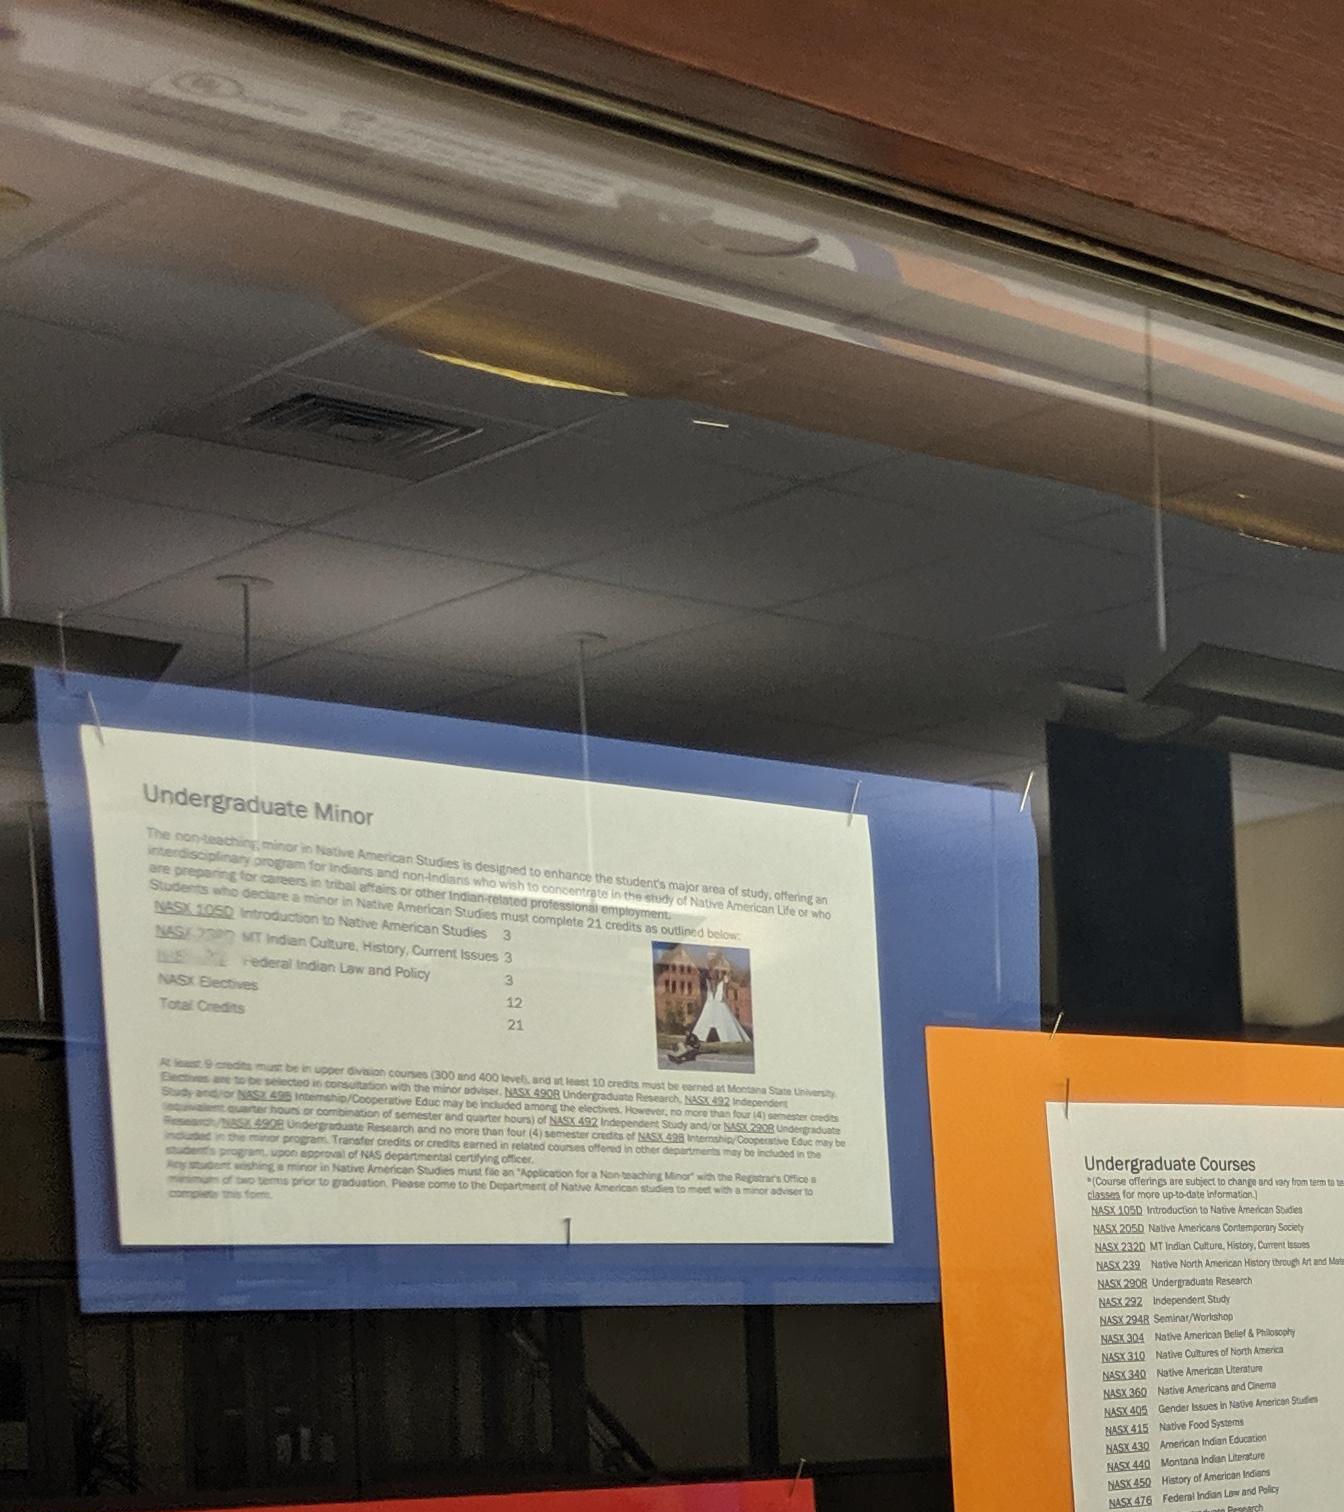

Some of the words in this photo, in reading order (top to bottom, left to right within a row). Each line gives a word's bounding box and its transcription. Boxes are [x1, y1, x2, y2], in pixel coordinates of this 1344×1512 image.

[142, 784, 308, 818] Undergraduate
[313, 801, 374, 825] Minor
[153, 899, 195, 917] NASX
[239, 907, 319, 924] Introduction
[337, 914, 378, 930] Native
[380, 919, 439, 934] American
[440, 923, 488, 939] Studies
[502, 928, 511, 942] 3
[241, 930, 262, 943] MT
[265, 933, 307, 946] Indian
[308, 935, 358, 952] Culture,
[361, 940, 409, 957] History,
[410, 943, 458, 959] Current
[459, 948, 499, 962] Issues
[503, 950, 513, 964] 3
[295, 959, 336, 972] Indian
[338, 961, 365, 975] Law
[366, 965, 392, 977] and
[394, 965, 431, 982] Policy
[503, 973, 514, 986] 3
[157, 972, 195, 986] NASX
[505, 996, 523, 1009] 12
[158, 996, 194, 1011] Total
[195, 999, 245, 1014] Credits
[506, 1018, 524, 1031] 21
[1083, 1155, 1196, 1174] Undergraduate
[1199, 1155, 1256, 1172] Courses
[1090, 1204, 1117, 1217] NASX
[1145, 1204, 1198, 1215] Introduction
[1209, 1204, 1236, 1214] Native
[1237, 1204, 1274, 1214] American
[1274, 1204, 1303, 1214] Studies
[1099, 1333, 1126, 1345] NASX
[1124, 1332, 1145, 1344] 304
[1154, 1331, 1182, 1341] Native
[1183, 1330, 1222, 1340] American
[1107, 1478, 1133, 1492] NASX
[1131, 1476, 1152, 1489] 450
[1160, 1475, 1192, 1486] History
[1202, 1471, 1241, 1482] American
[1241, 1468, 1271, 1478] Indians
